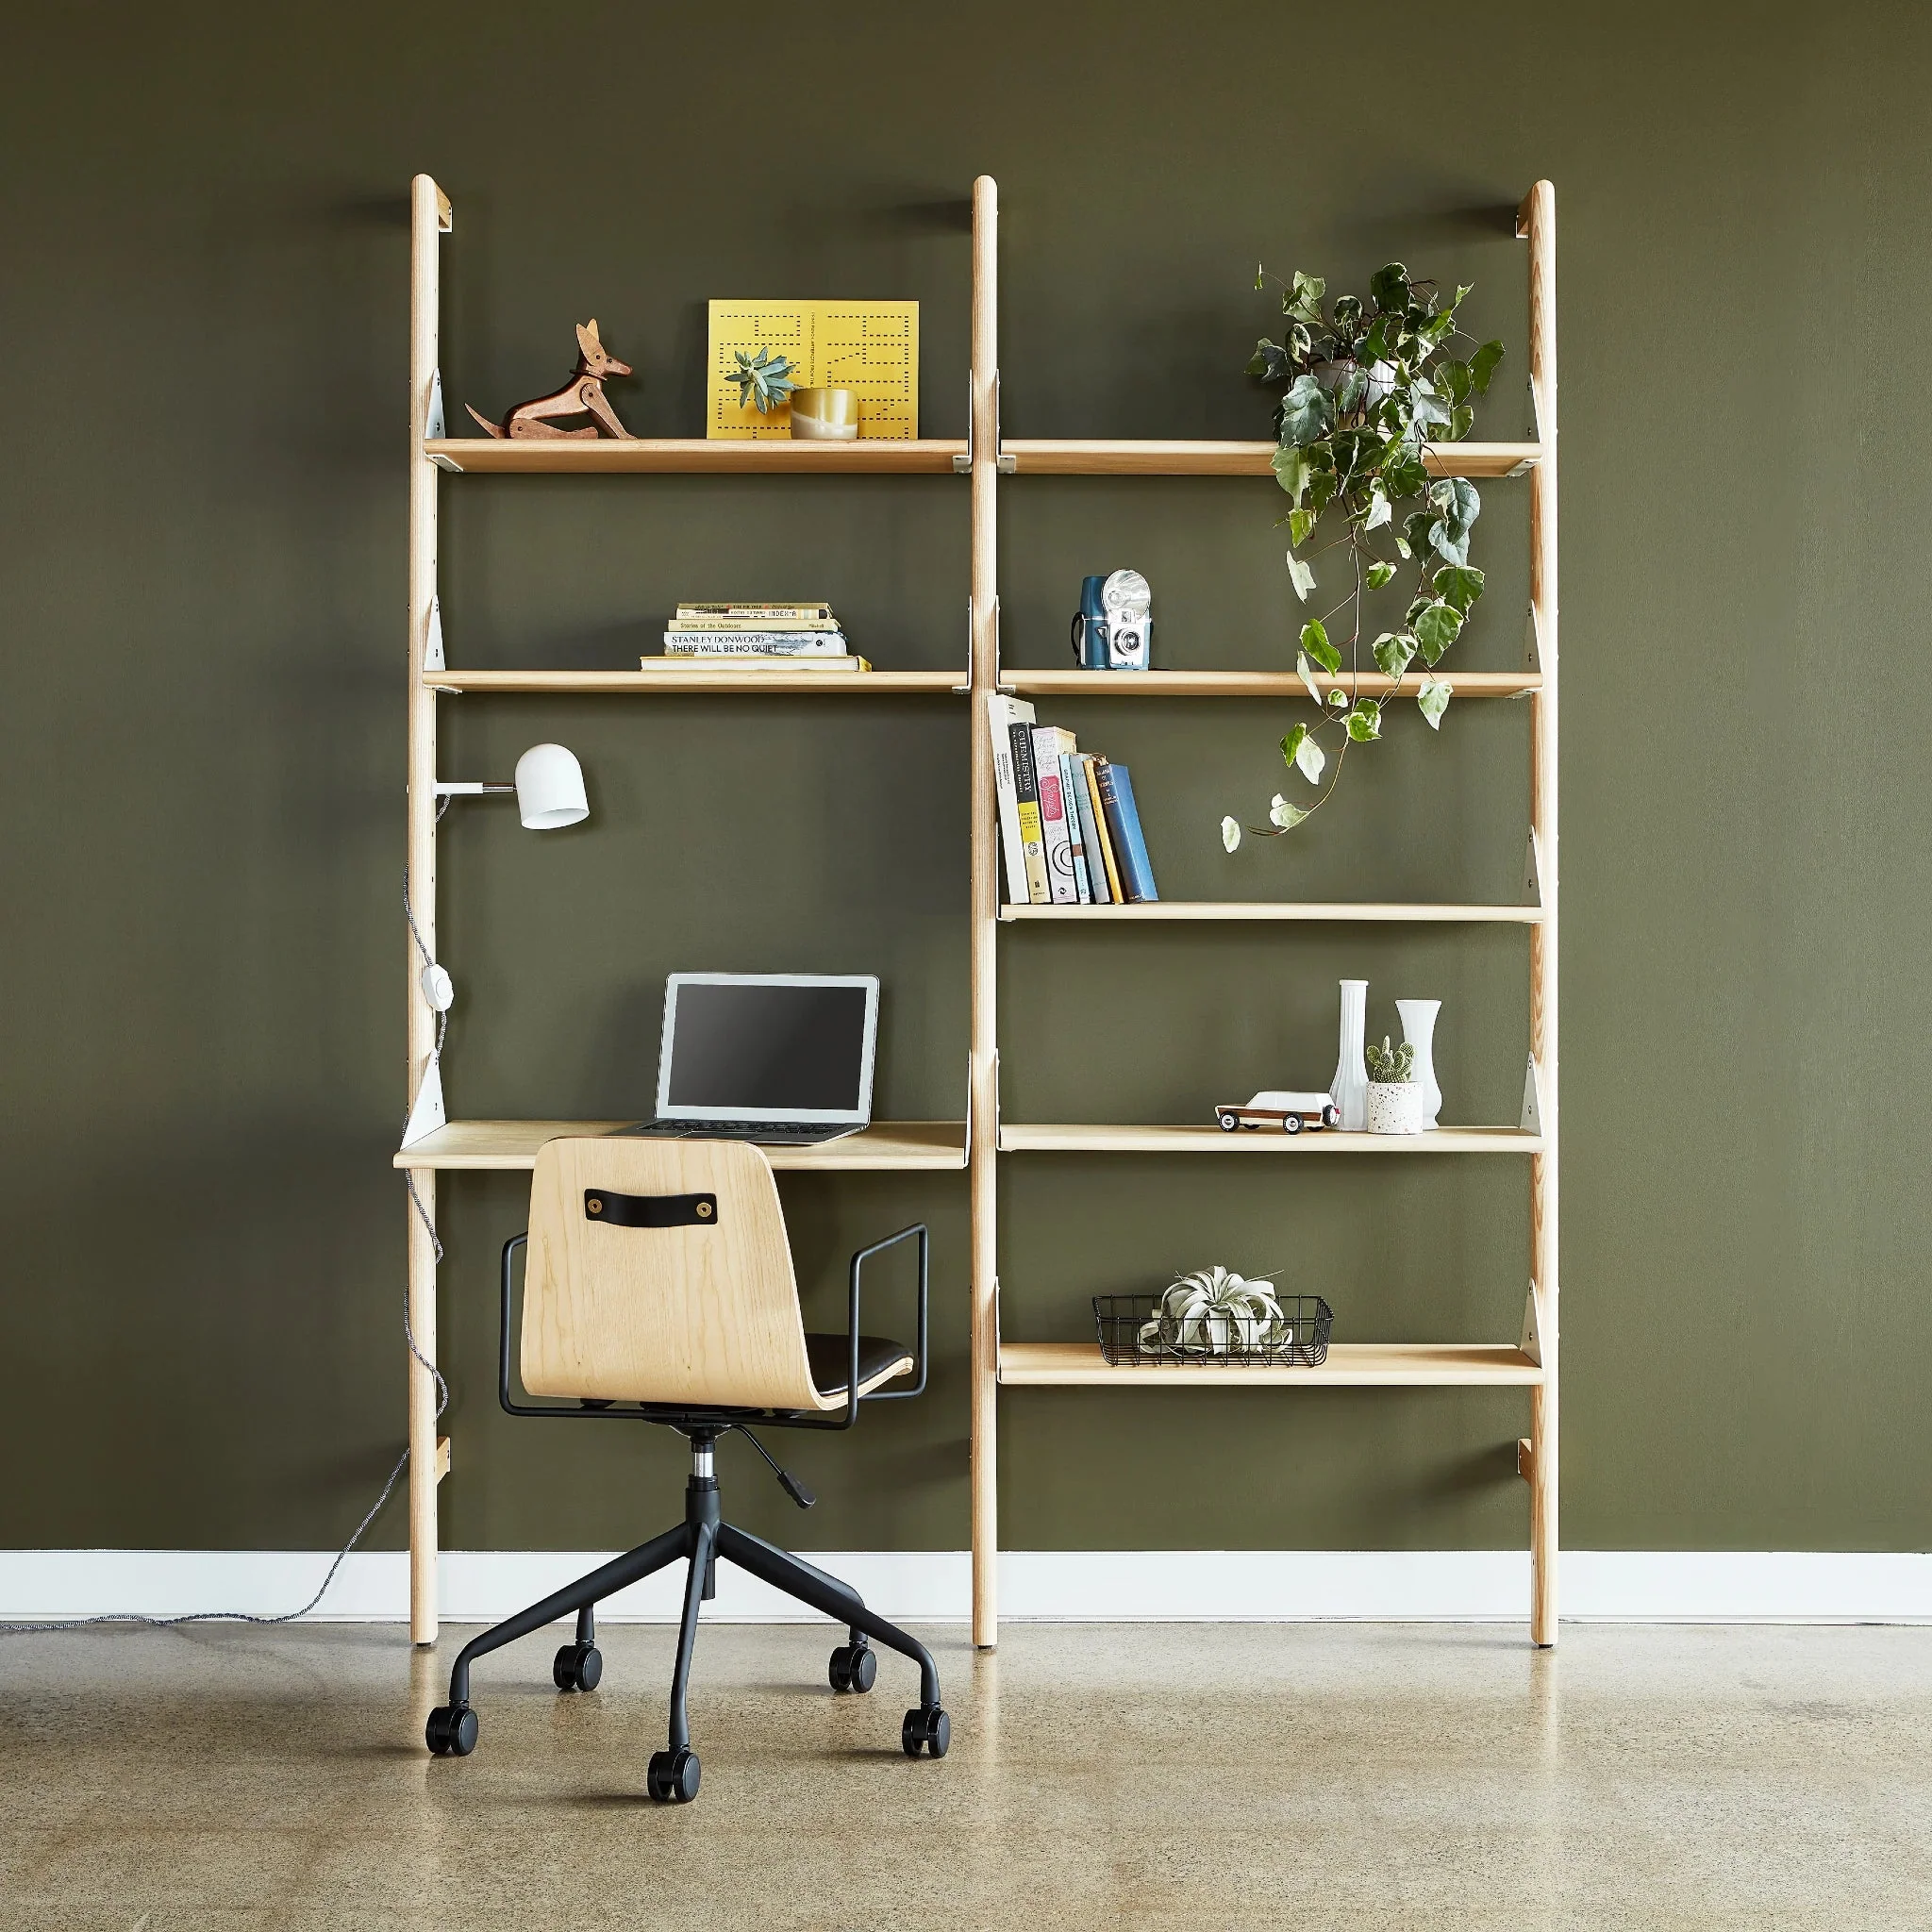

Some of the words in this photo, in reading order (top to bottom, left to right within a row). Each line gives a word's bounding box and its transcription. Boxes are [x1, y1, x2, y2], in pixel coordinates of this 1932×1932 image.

[673, 644, 699, 653] THERE
[700, 644, 722, 653] WILL
[724, 644, 735, 653] BE
[736, 644, 750, 653] NO
[751, 644, 778, 653] QUIET
[1018, 730, 1032, 791] CHEMISTRY
[1040, 777, 1059, 817] Scripts
